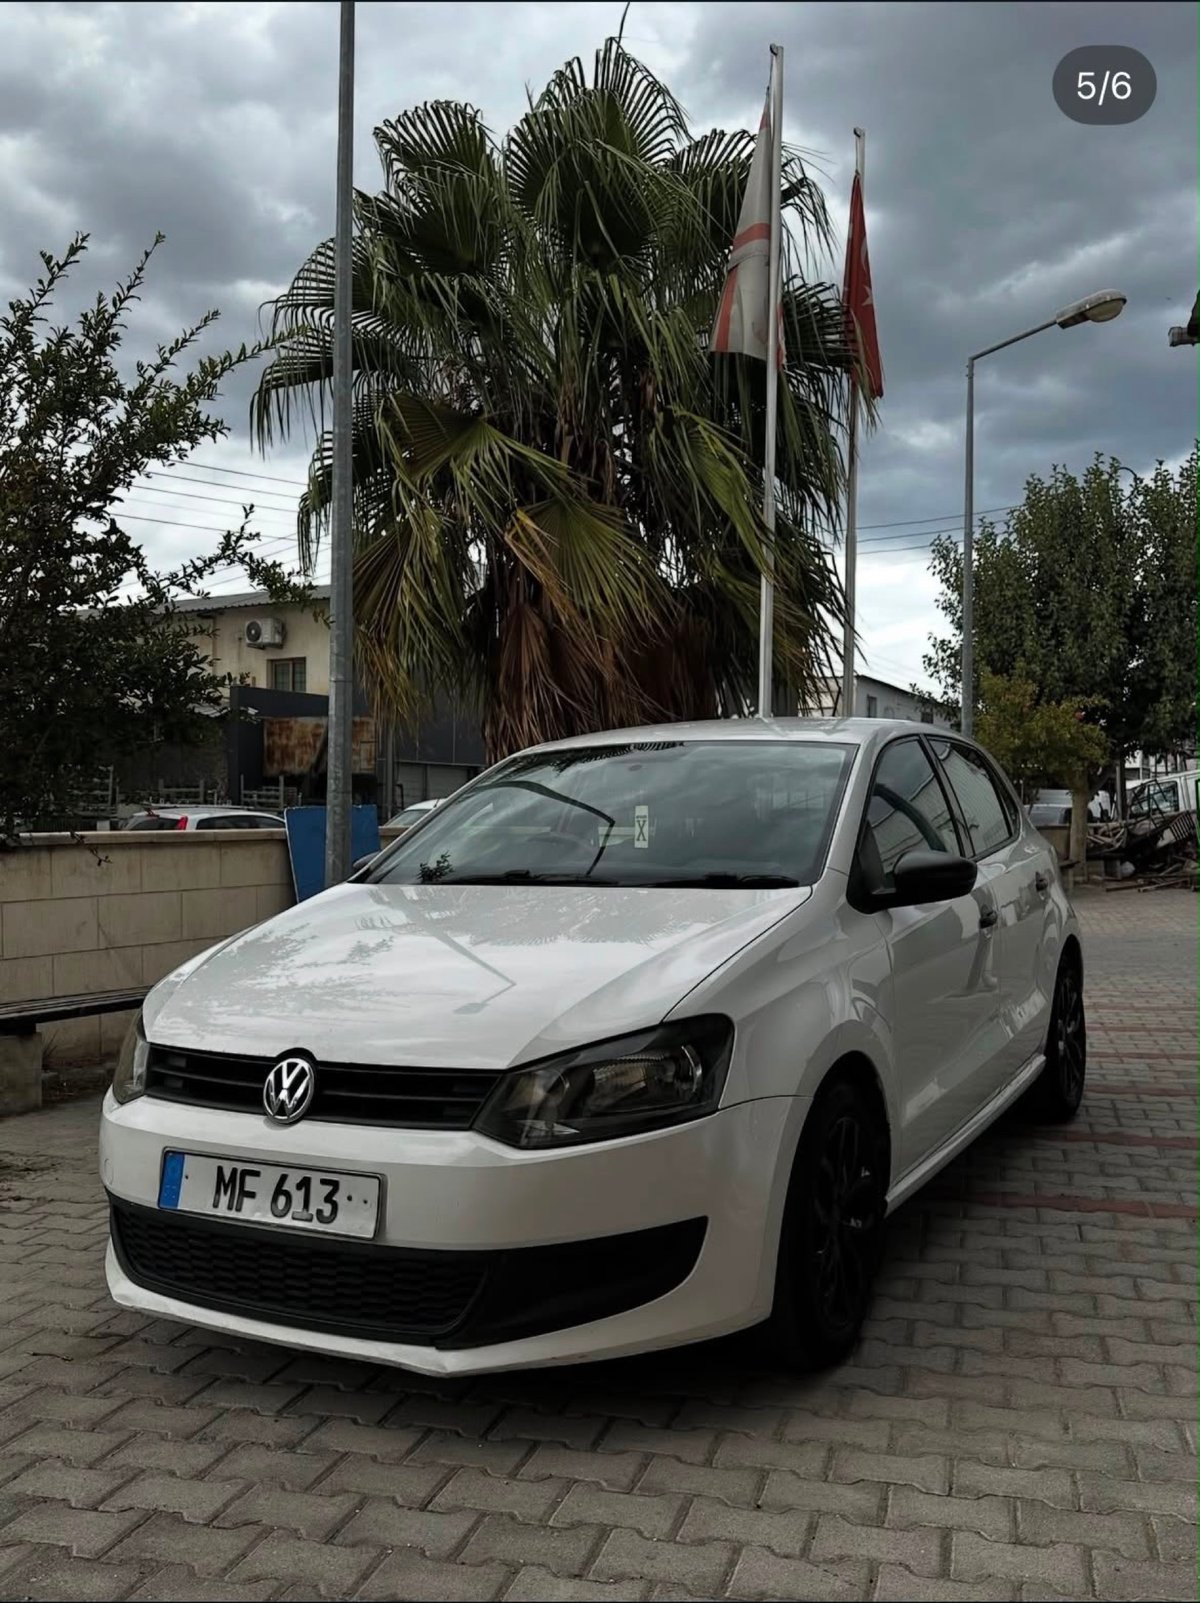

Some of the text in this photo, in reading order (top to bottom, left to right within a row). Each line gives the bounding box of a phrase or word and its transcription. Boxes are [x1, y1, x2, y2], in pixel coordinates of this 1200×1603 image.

[264, 1058, 313, 1119] VW
[212, 1165, 340, 1224] MF 613
